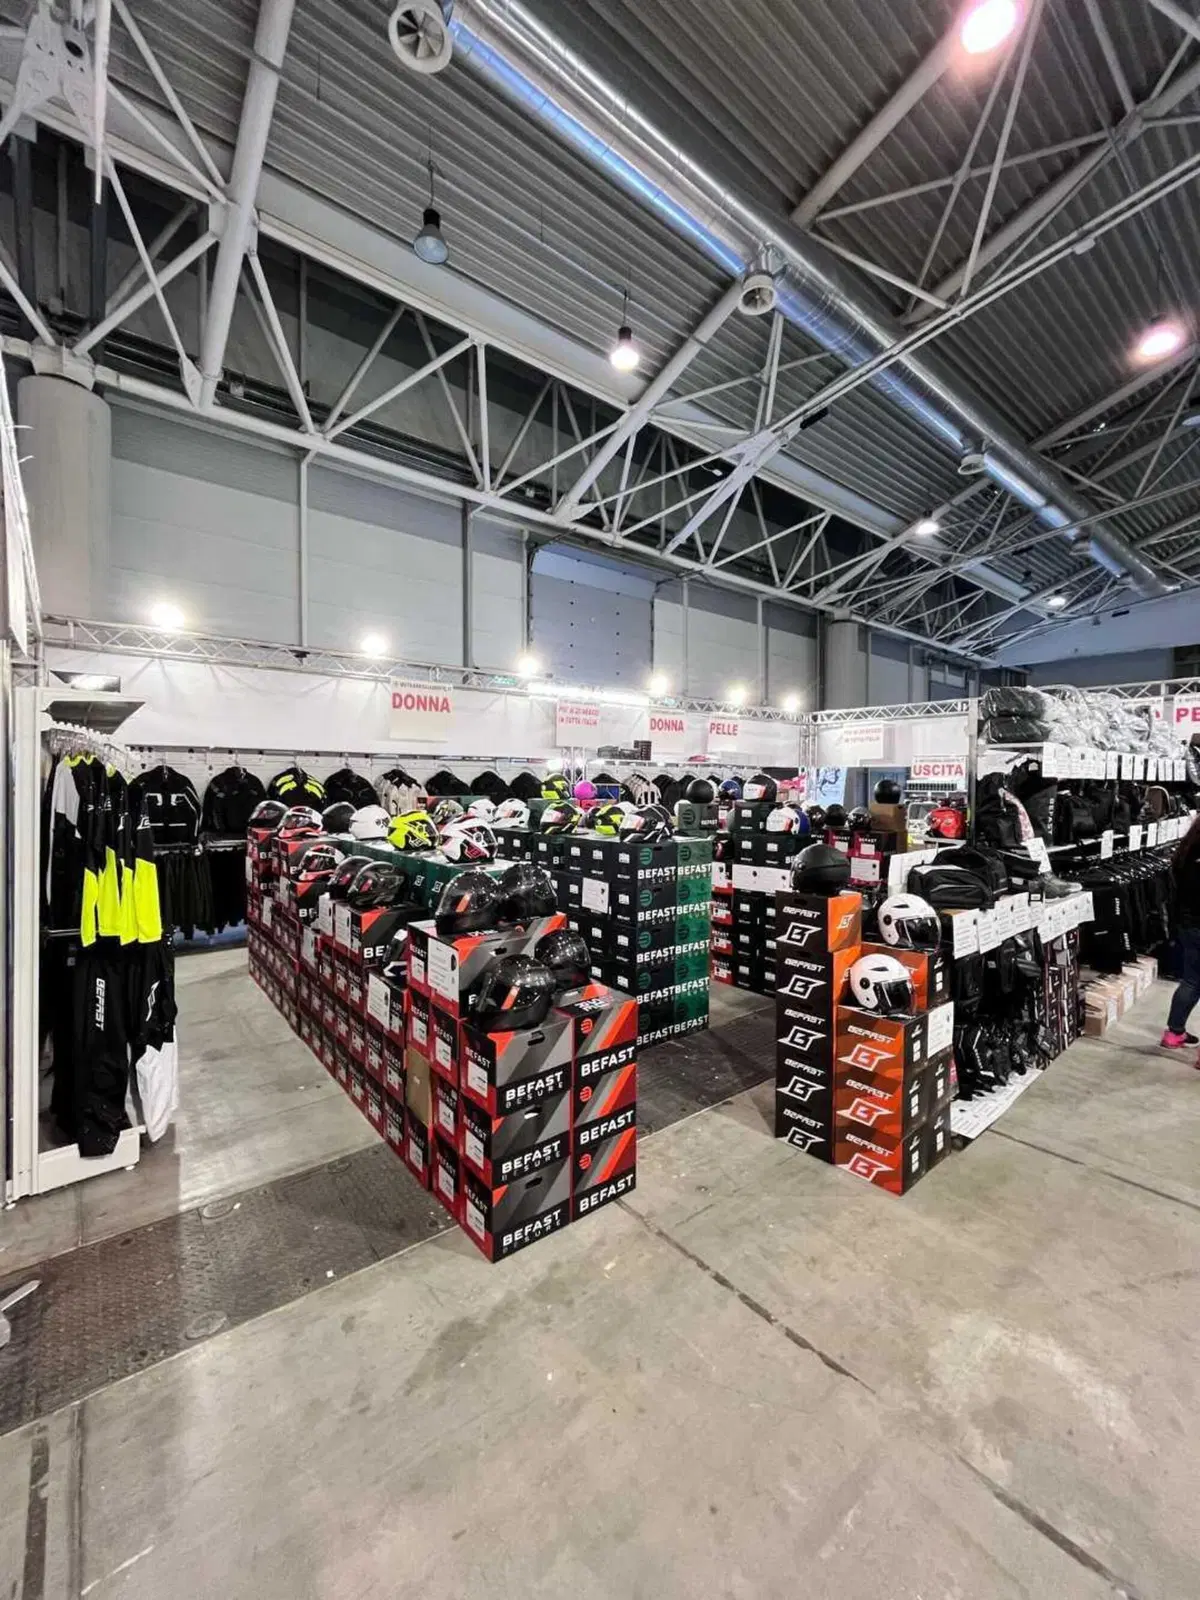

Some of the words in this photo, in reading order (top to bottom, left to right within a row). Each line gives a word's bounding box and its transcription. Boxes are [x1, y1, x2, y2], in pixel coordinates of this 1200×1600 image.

[392, 693, 451, 713] DONNA
[650, 718, 684, 732] DONNA
[709, 722, 738, 736] PELLE
[913, 764, 963, 776] USCITA
[637, 866, 676, 880] BEFAST
[677, 863, 712, 876] BEFAST
[637, 907, 676, 921] BEFAST
[676, 901, 711, 915] BEFAST
[782, 905, 821, 919] BEFAST
[636, 946, 675, 963] BEFAST
[675, 939, 711, 955] BEFAST
[784, 957, 826, 973] BEFAST
[674, 977, 710, 994] BEFAST
[95, 977, 106, 1032] BEFAST
[636, 987, 675, 1005] BEFAST
[674, 1014, 709, 1034] BEFAST
[784, 1008, 826, 1026] BEFAST
[636, 1025, 675, 1046] BEFAST
[847, 1024, 896, 1044] BEFAST
[465, 1045, 491, 1069] BEFAST
[581, 1046, 635, 1077] BEFAST
[784, 1057, 826, 1077] BEFAST
[505, 1071, 564, 1102] BEFAST
[845, 1078, 894, 1100] BEFAST
[463, 1114, 488, 1142] BEFAST
[579, 1110, 634, 1145] BEFAST
[783, 1107, 825, 1129] BEFAST
[845, 1133, 895, 1157] BEFAST
[501, 1140, 561, 1175] BEFAST
[464, 1183, 488, 1214] BEFAST
[579, 1174, 634, 1213] BEFAST
[502, 1209, 562, 1247] BEFAST
